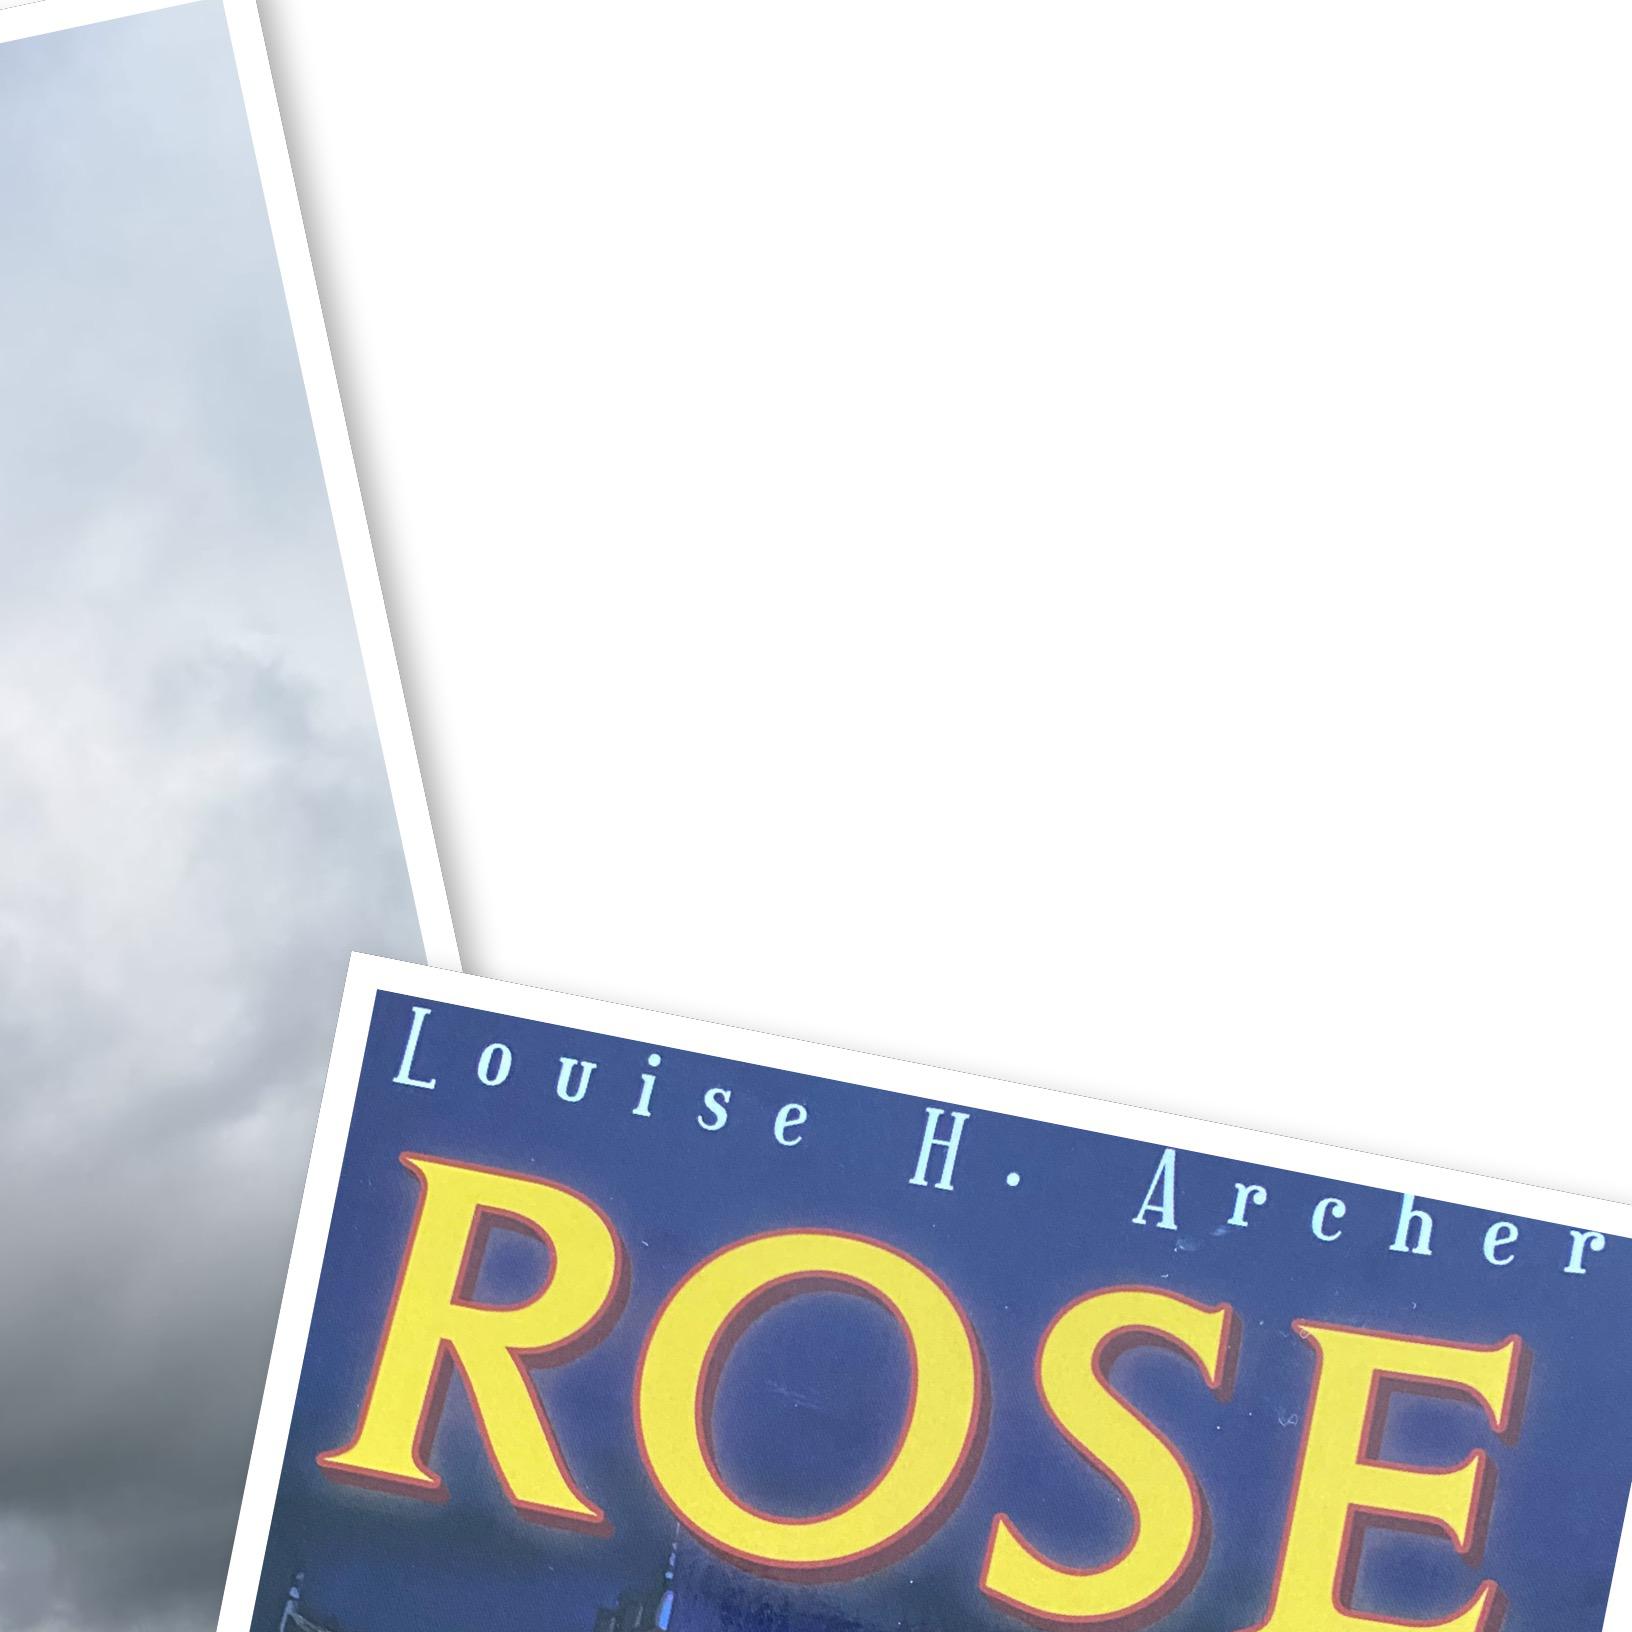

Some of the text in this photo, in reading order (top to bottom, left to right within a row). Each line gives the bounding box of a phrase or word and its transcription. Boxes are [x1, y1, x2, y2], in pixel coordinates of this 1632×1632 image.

[392, 1006, 1606, 1275] Louise H. Archer
